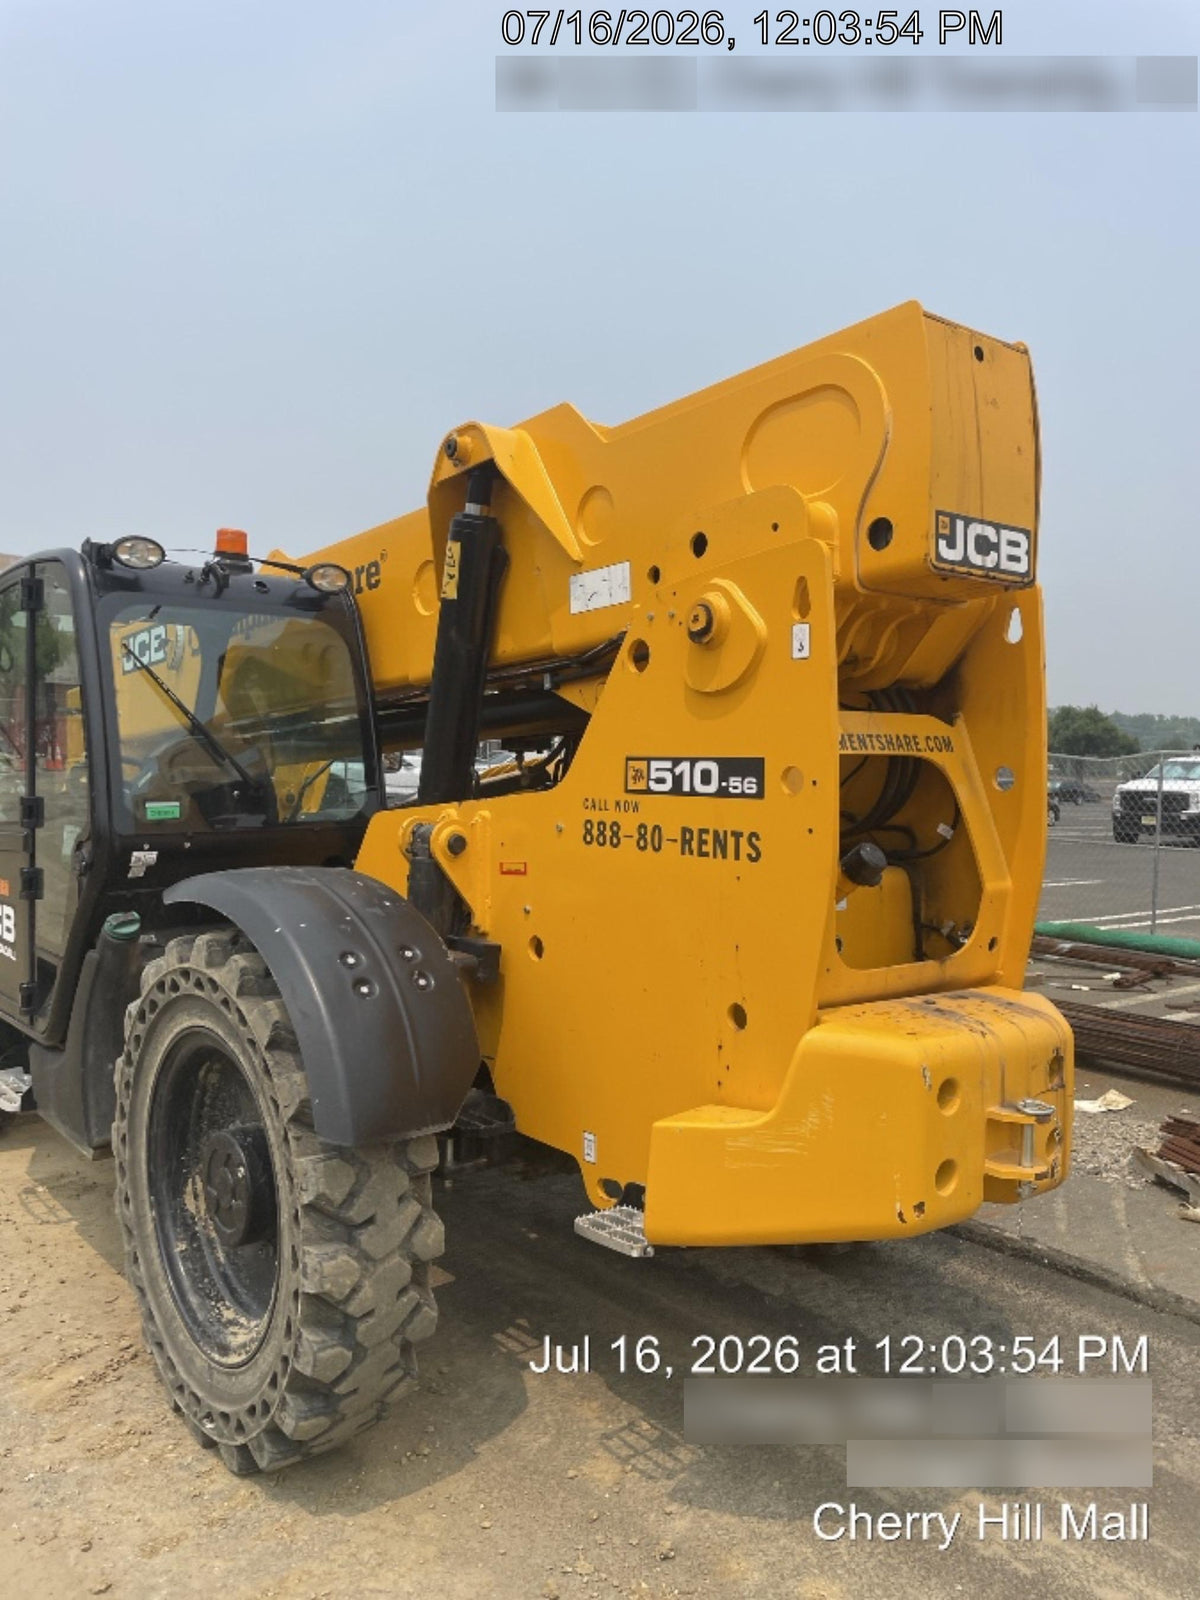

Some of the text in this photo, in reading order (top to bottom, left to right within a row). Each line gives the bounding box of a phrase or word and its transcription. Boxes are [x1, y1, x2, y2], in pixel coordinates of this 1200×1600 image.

[938, 518, 1029, 574] JCB
[648, 760, 758, 794] 510-56
[582, 797, 640, 813] CALL NOW
[582, 819, 762, 863] 888-80-RENTS
